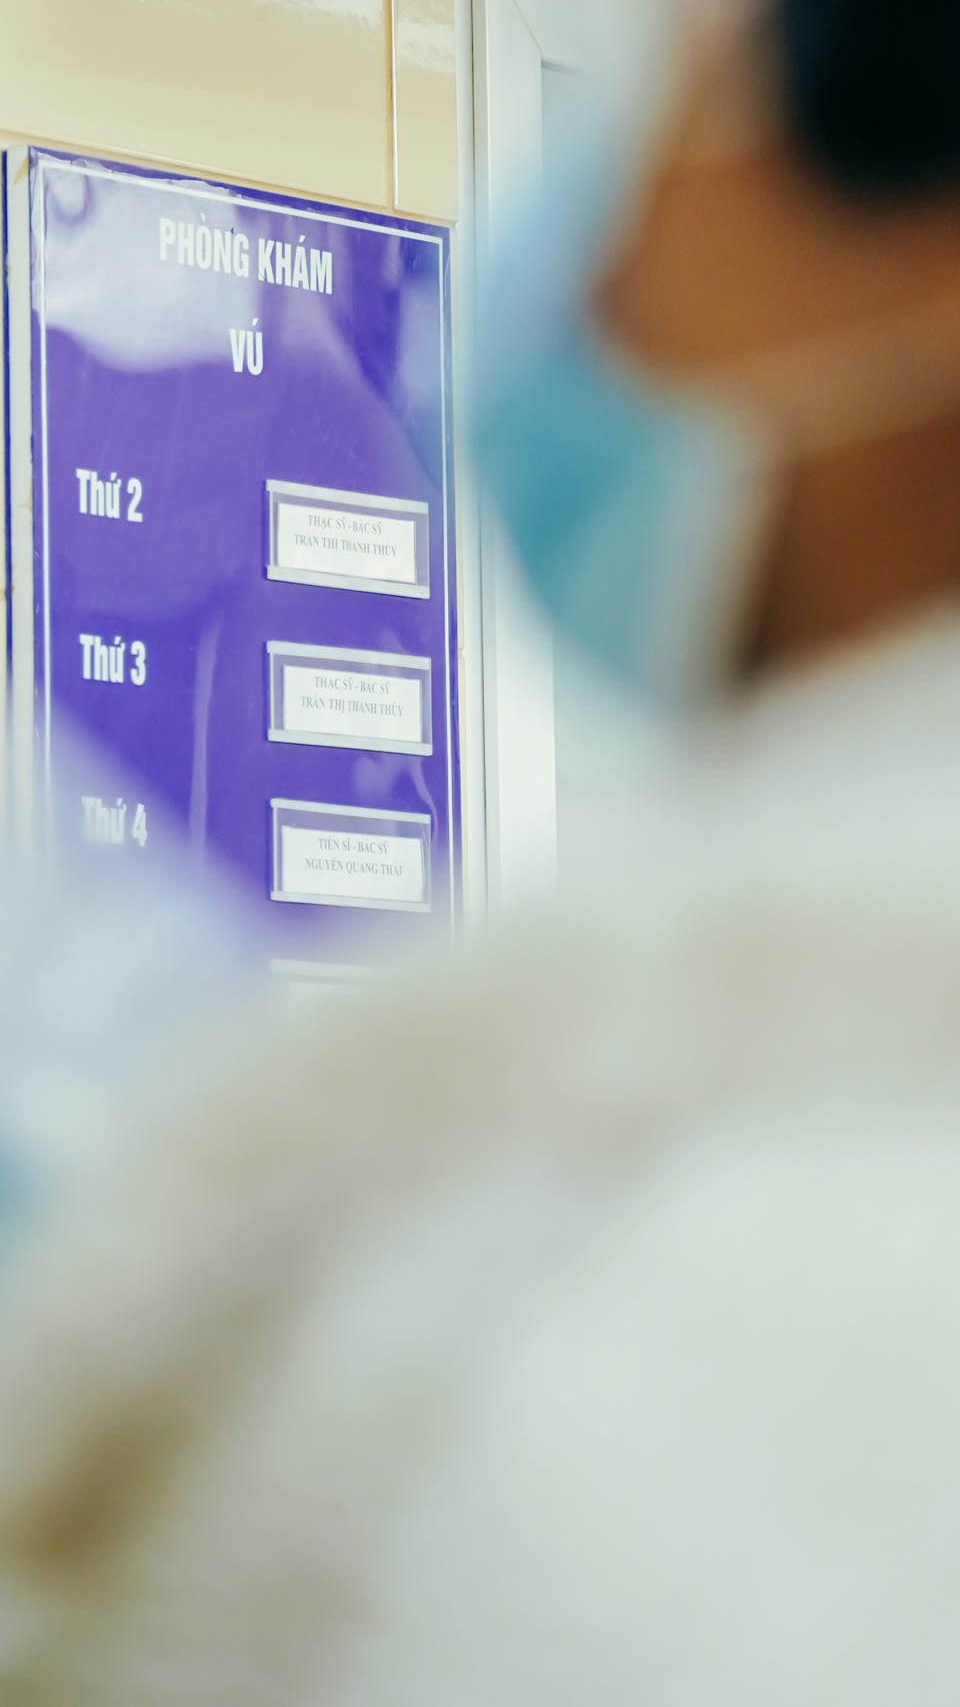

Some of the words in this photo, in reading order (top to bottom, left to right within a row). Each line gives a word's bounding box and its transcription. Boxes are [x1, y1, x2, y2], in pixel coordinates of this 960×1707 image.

[158, 211, 251, 279] PHÒNG
[257, 233, 334, 295] KHÁM
[229, 318, 265, 376] VÚ
[76, 468, 122, 522] Thứ
[126, 478, 144, 523] 2
[308, 514, 334, 531] THẠC
[352, 518, 369, 534] BÁC
[322, 537, 338, 553] THỊ
[341, 539, 370, 554] THANH
[79, 634, 126, 685] Thứ
[129, 640, 147, 687] 3
[314, 676, 341, 692] THẠC
[360, 678, 377, 694] BÁC
[328, 698, 345, 713] THỊ
[347, 700, 377, 714] THANH
[81, 796, 127, 846] Thứ
[129, 803, 148, 848] 4
[358, 838, 376, 854] BÁC
[346, 861, 378, 876] QUANG
[381, 862, 402, 876] THÁI
